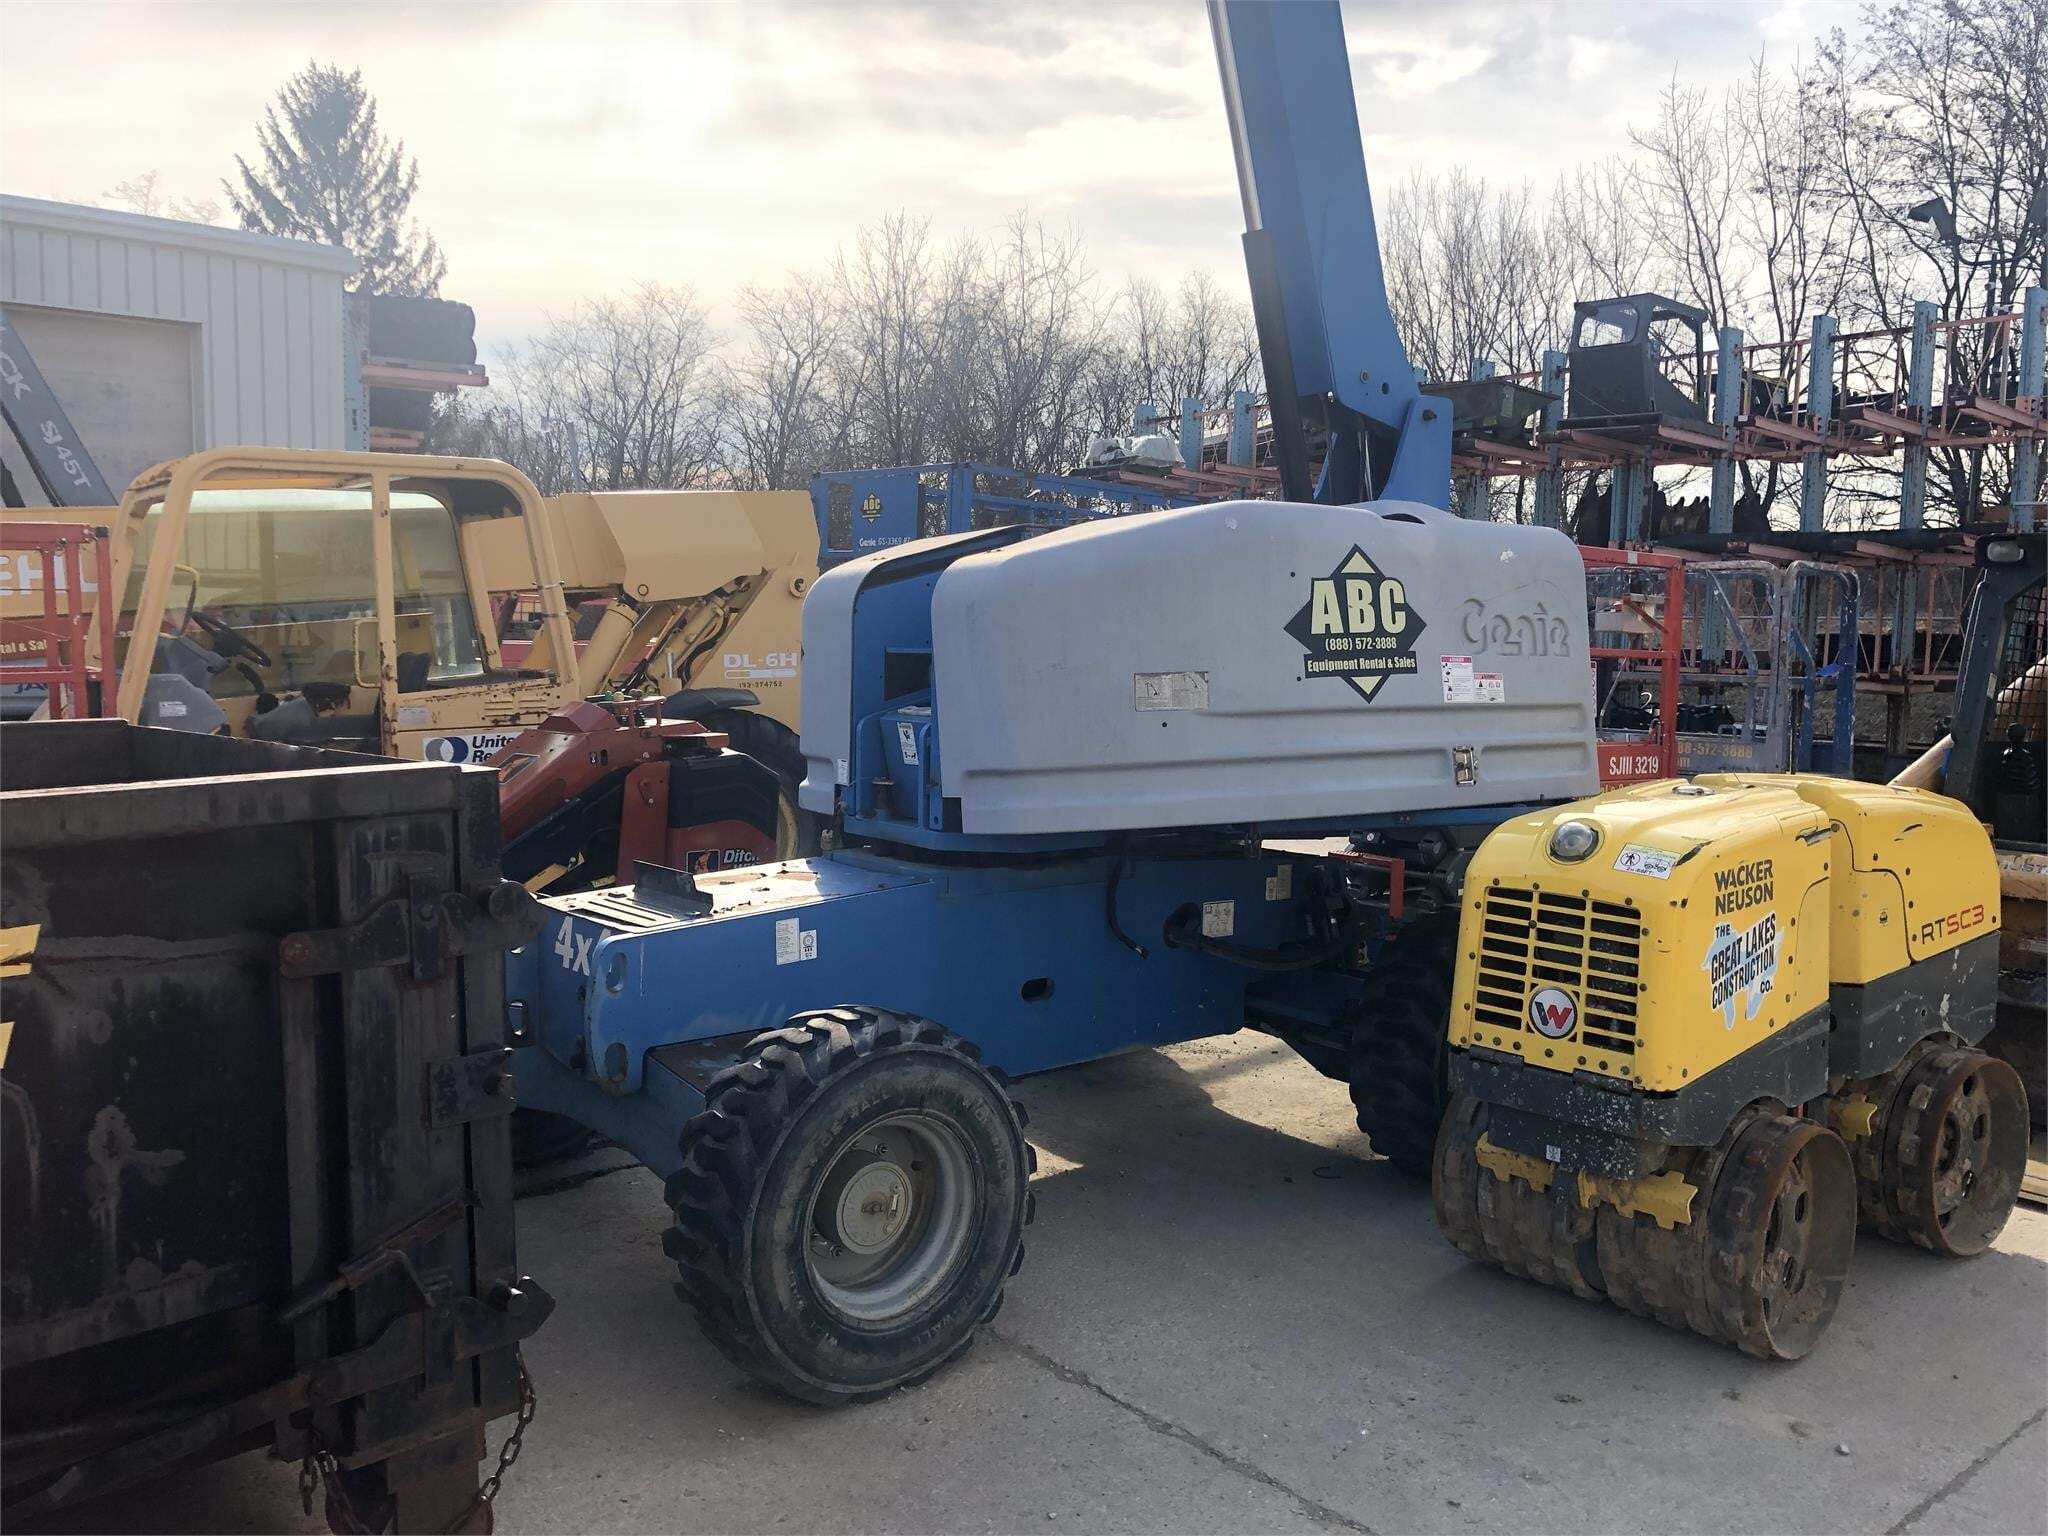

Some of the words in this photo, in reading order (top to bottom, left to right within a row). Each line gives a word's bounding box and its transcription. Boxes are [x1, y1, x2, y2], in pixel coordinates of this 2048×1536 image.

[0, 351, 32, 400] CK
[1311, 579, 1406, 635] ABC
[1325, 638, 1353, 651] (888)
[1355, 637, 1397, 650] 572-3888
[1463, 598, 1570, 656] Genie
[1307, 659, 1358, 672] Equipment
[1360, 657, 1386, 669] Rental
[1387, 659, 1393, 668] &
[1394, 656, 1416, 668] Sales
[1635, 756, 1658, 774] 3219
[1714, 859, 1773, 892] WACKER
[1715, 881, 1774, 917] NEUSON
[1715, 924, 1731, 939] THE
[1921, 904, 1985, 945] RTSC3
[1711, 935, 1743, 985] GREAT
[1745, 912, 1776, 959] LAKES
[1712, 943, 1775, 1010] CONSTRUCTION
[1760, 979, 1773, 994] CO.
